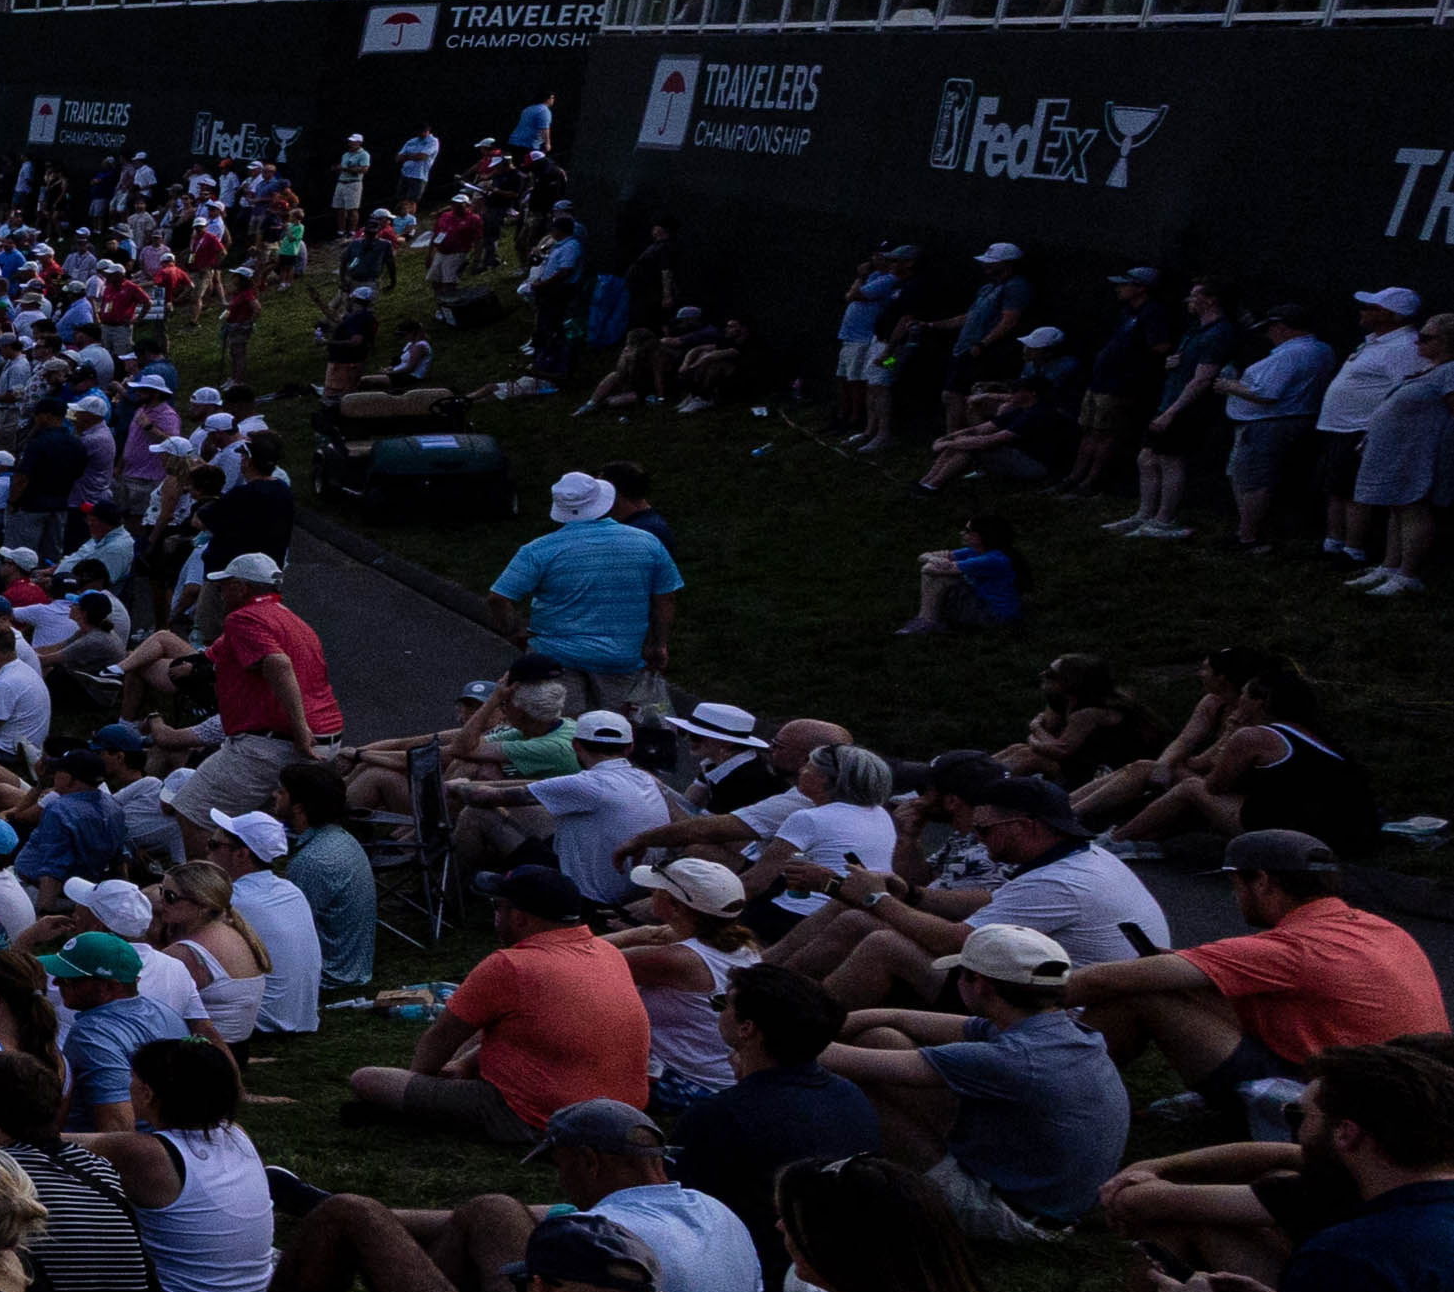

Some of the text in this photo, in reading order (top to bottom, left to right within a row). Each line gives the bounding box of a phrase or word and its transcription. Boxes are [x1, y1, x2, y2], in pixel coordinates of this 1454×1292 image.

[445, 32, 590, 50] CHAMPIONSH
[703, 63, 824, 111] TRAVELERS
[61, 100, 134, 127] TRAVELERS
[58, 129, 127, 147] CHAMPIONSHIP
[208, 120, 270, 160] FedEx
[692, 120, 812, 156] CHAMPIONSHIP
[964, 95, 1101, 184] FedEx
